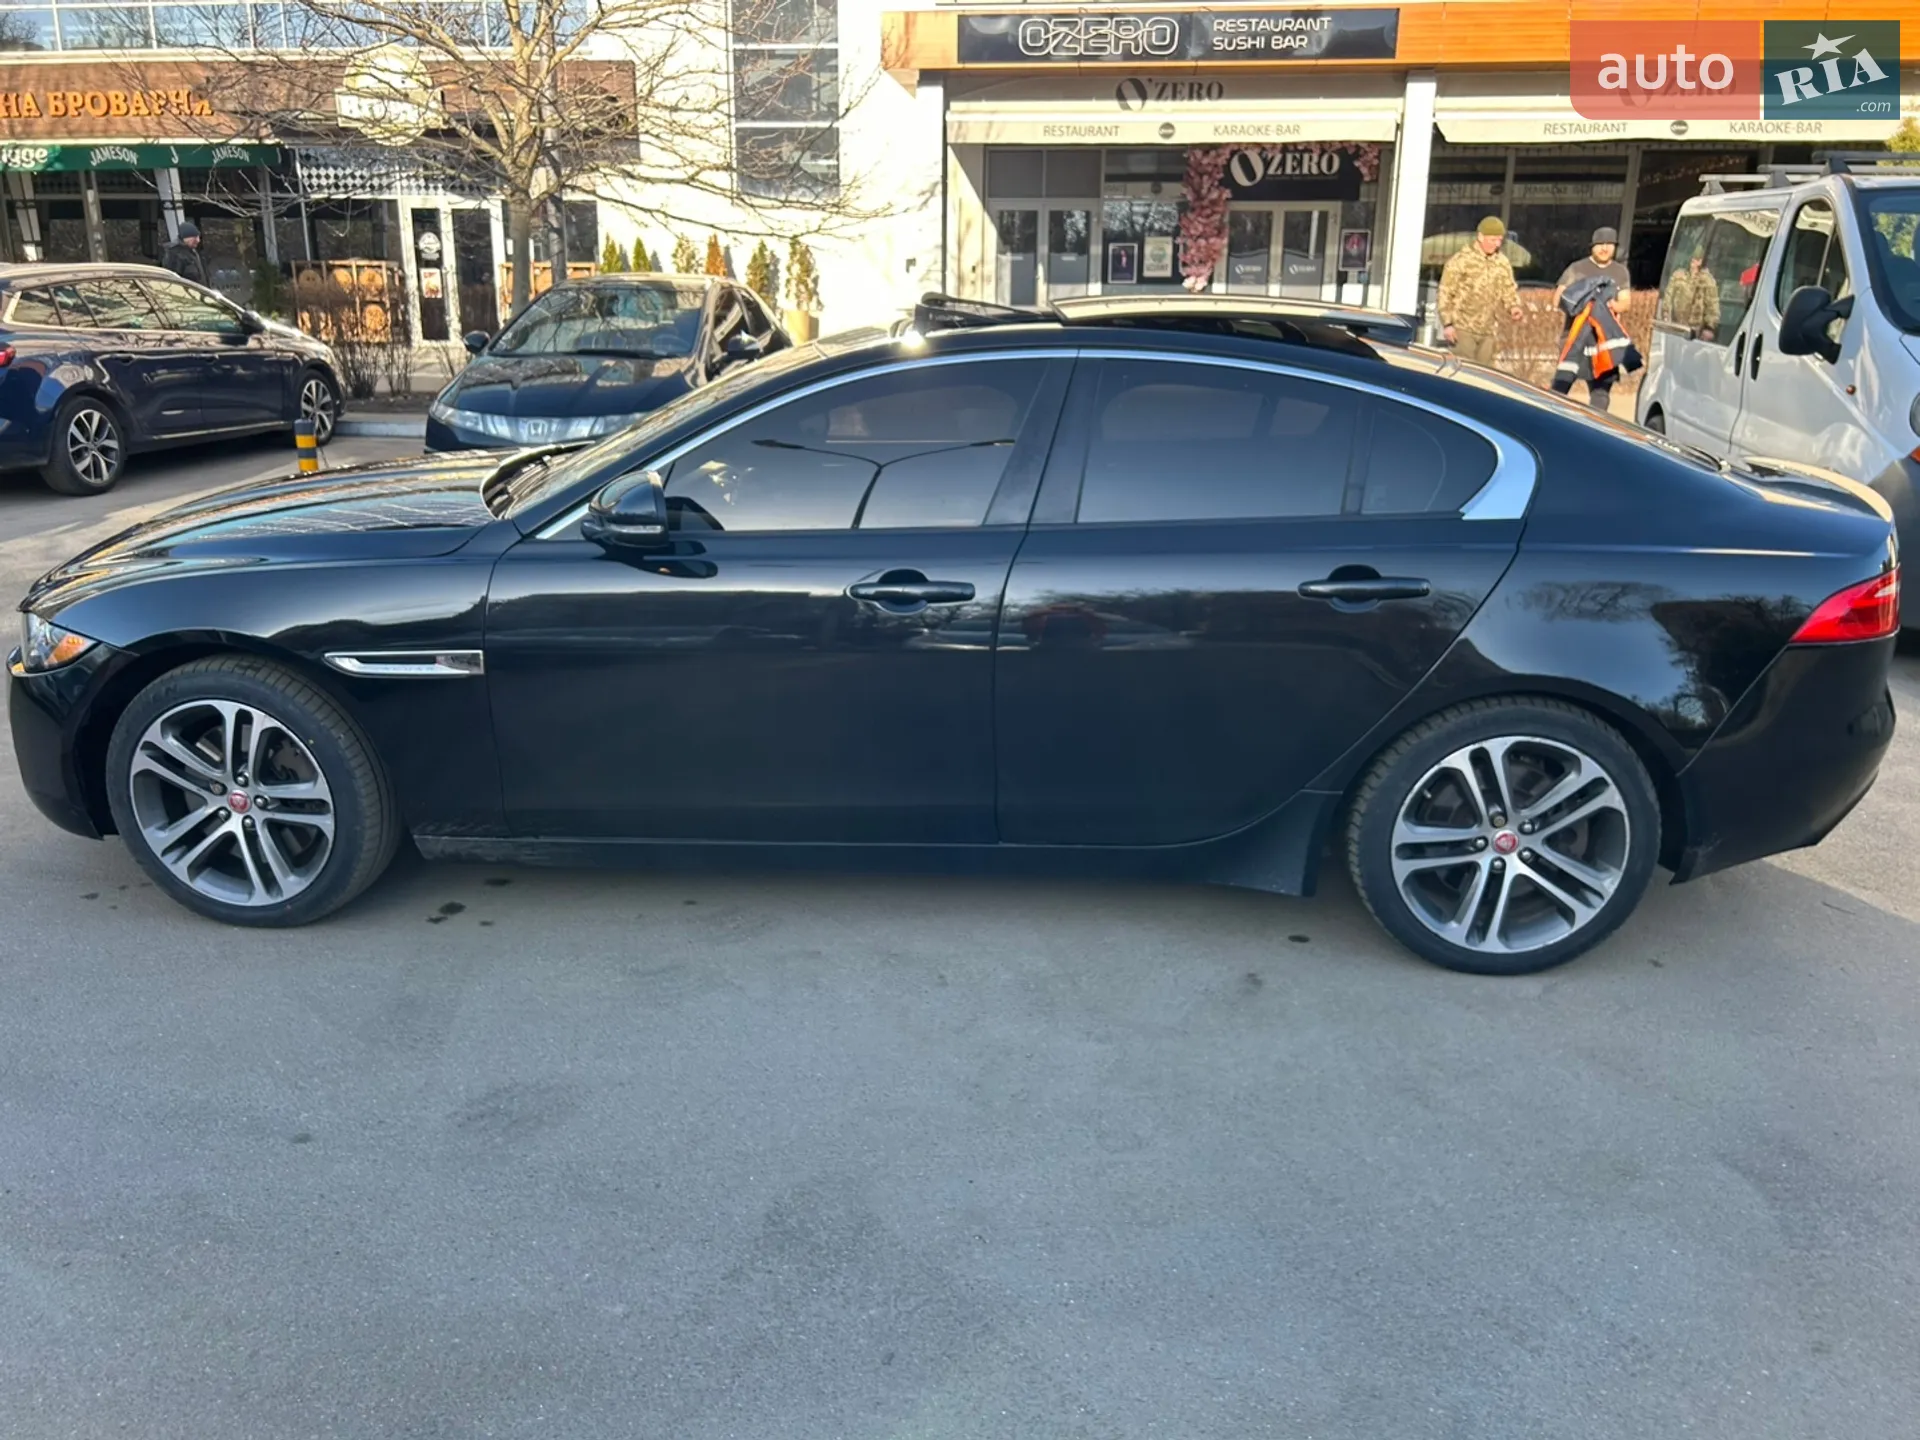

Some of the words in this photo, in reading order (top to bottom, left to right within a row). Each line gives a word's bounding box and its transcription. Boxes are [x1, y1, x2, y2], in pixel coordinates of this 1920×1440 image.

[1212, 17, 1332, 33] RESTAURANT
[1018, 17, 1180, 56] OZERO
[1212, 35, 1266, 51] SUSHI
[1271, 35, 1308, 50] BAR
[1042, 124, 1121, 137] RESTAURANT
[1212, 124, 1301, 138] KARAOKE-BAR
[1542, 121, 1628, 136] RESTAURANT
[1728, 121, 1823, 135] KARAOKE-BAR
[89, 146, 139, 167] JAMESON
[211, 145, 250, 164] JAMESON
